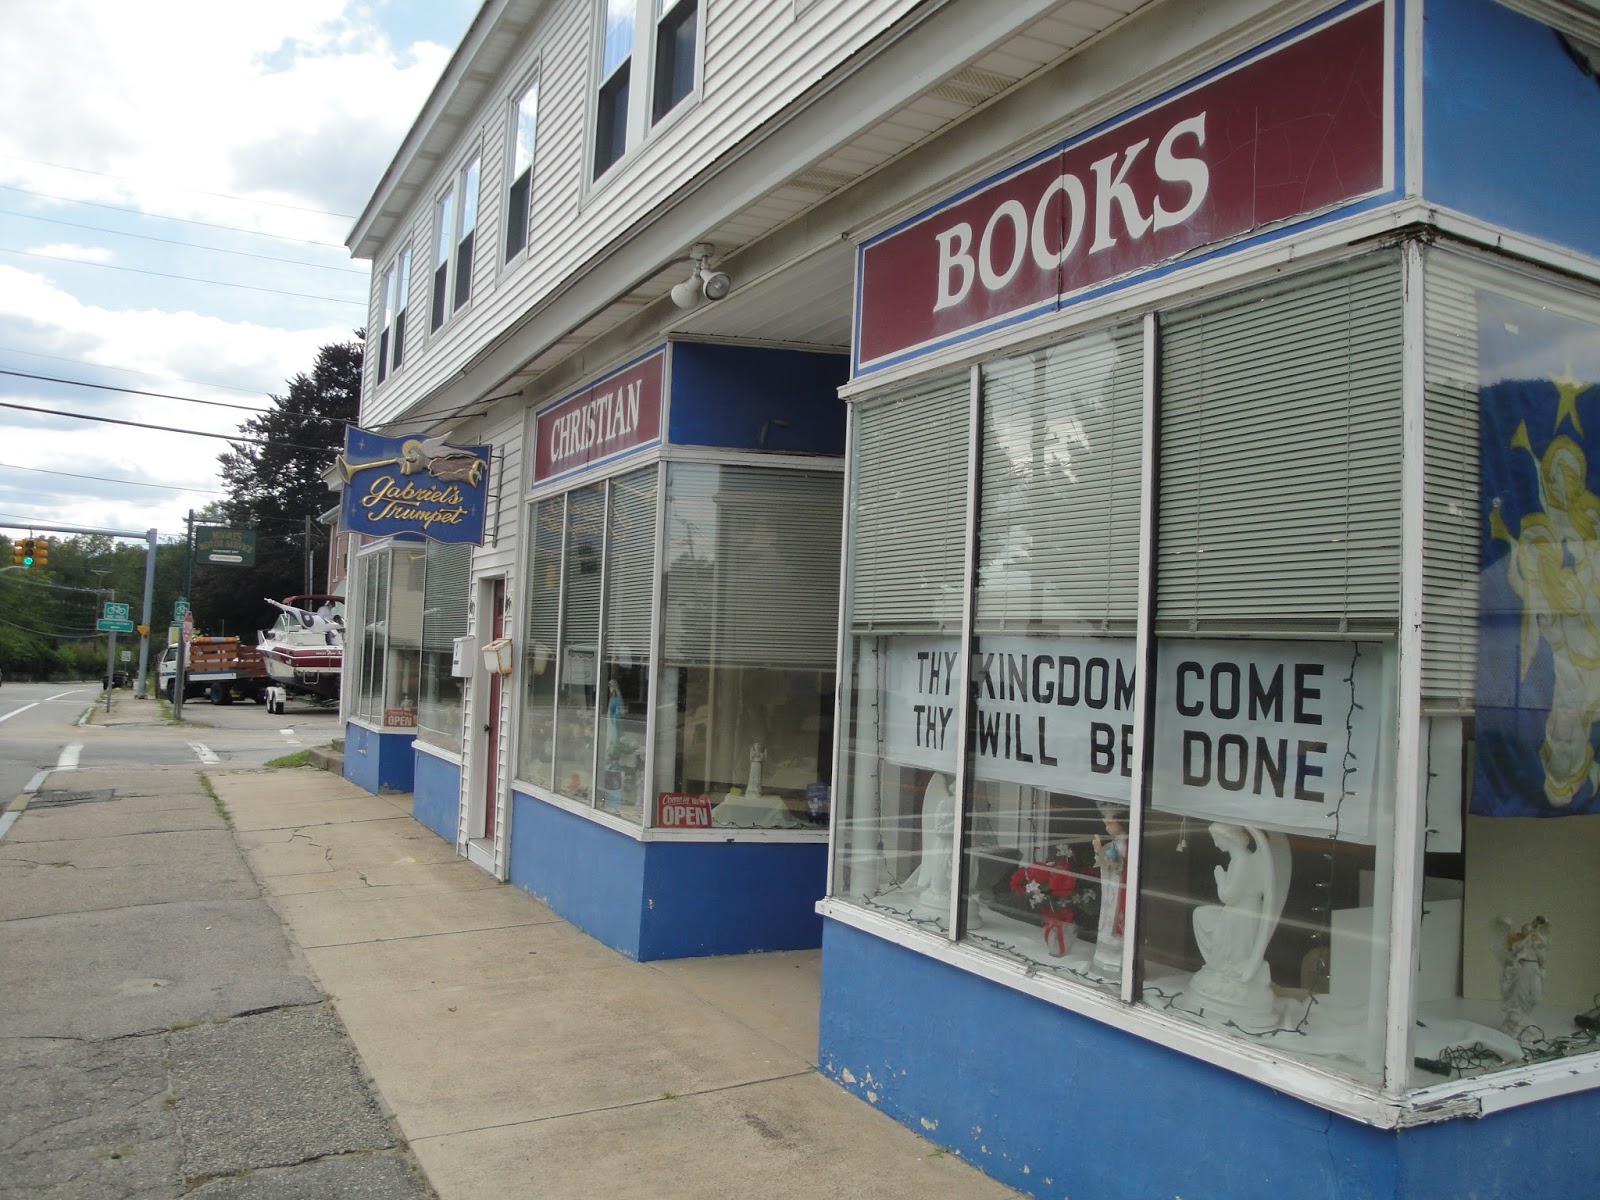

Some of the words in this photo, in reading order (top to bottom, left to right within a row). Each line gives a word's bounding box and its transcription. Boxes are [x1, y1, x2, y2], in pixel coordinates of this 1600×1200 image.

[933, 111, 1210, 312] BOOKS
[550, 379, 642, 463] CHRISTIAN
[362, 475, 464, 507] Gabriel's
[368, 501, 468, 530] Trumpet
[917, 652, 957, 695] THY
[973, 652, 1135, 711] KINGDOM
[1176, 661, 1324, 725] COME
[388, 715, 412, 726] OPEN
[914, 705, 953, 750] THY
[979, 710, 1058, 767] WILL
[1091, 721, 1134, 777] BE
[1183, 730, 1327, 803] DONE
[663, 805, 709, 826] OPEN
